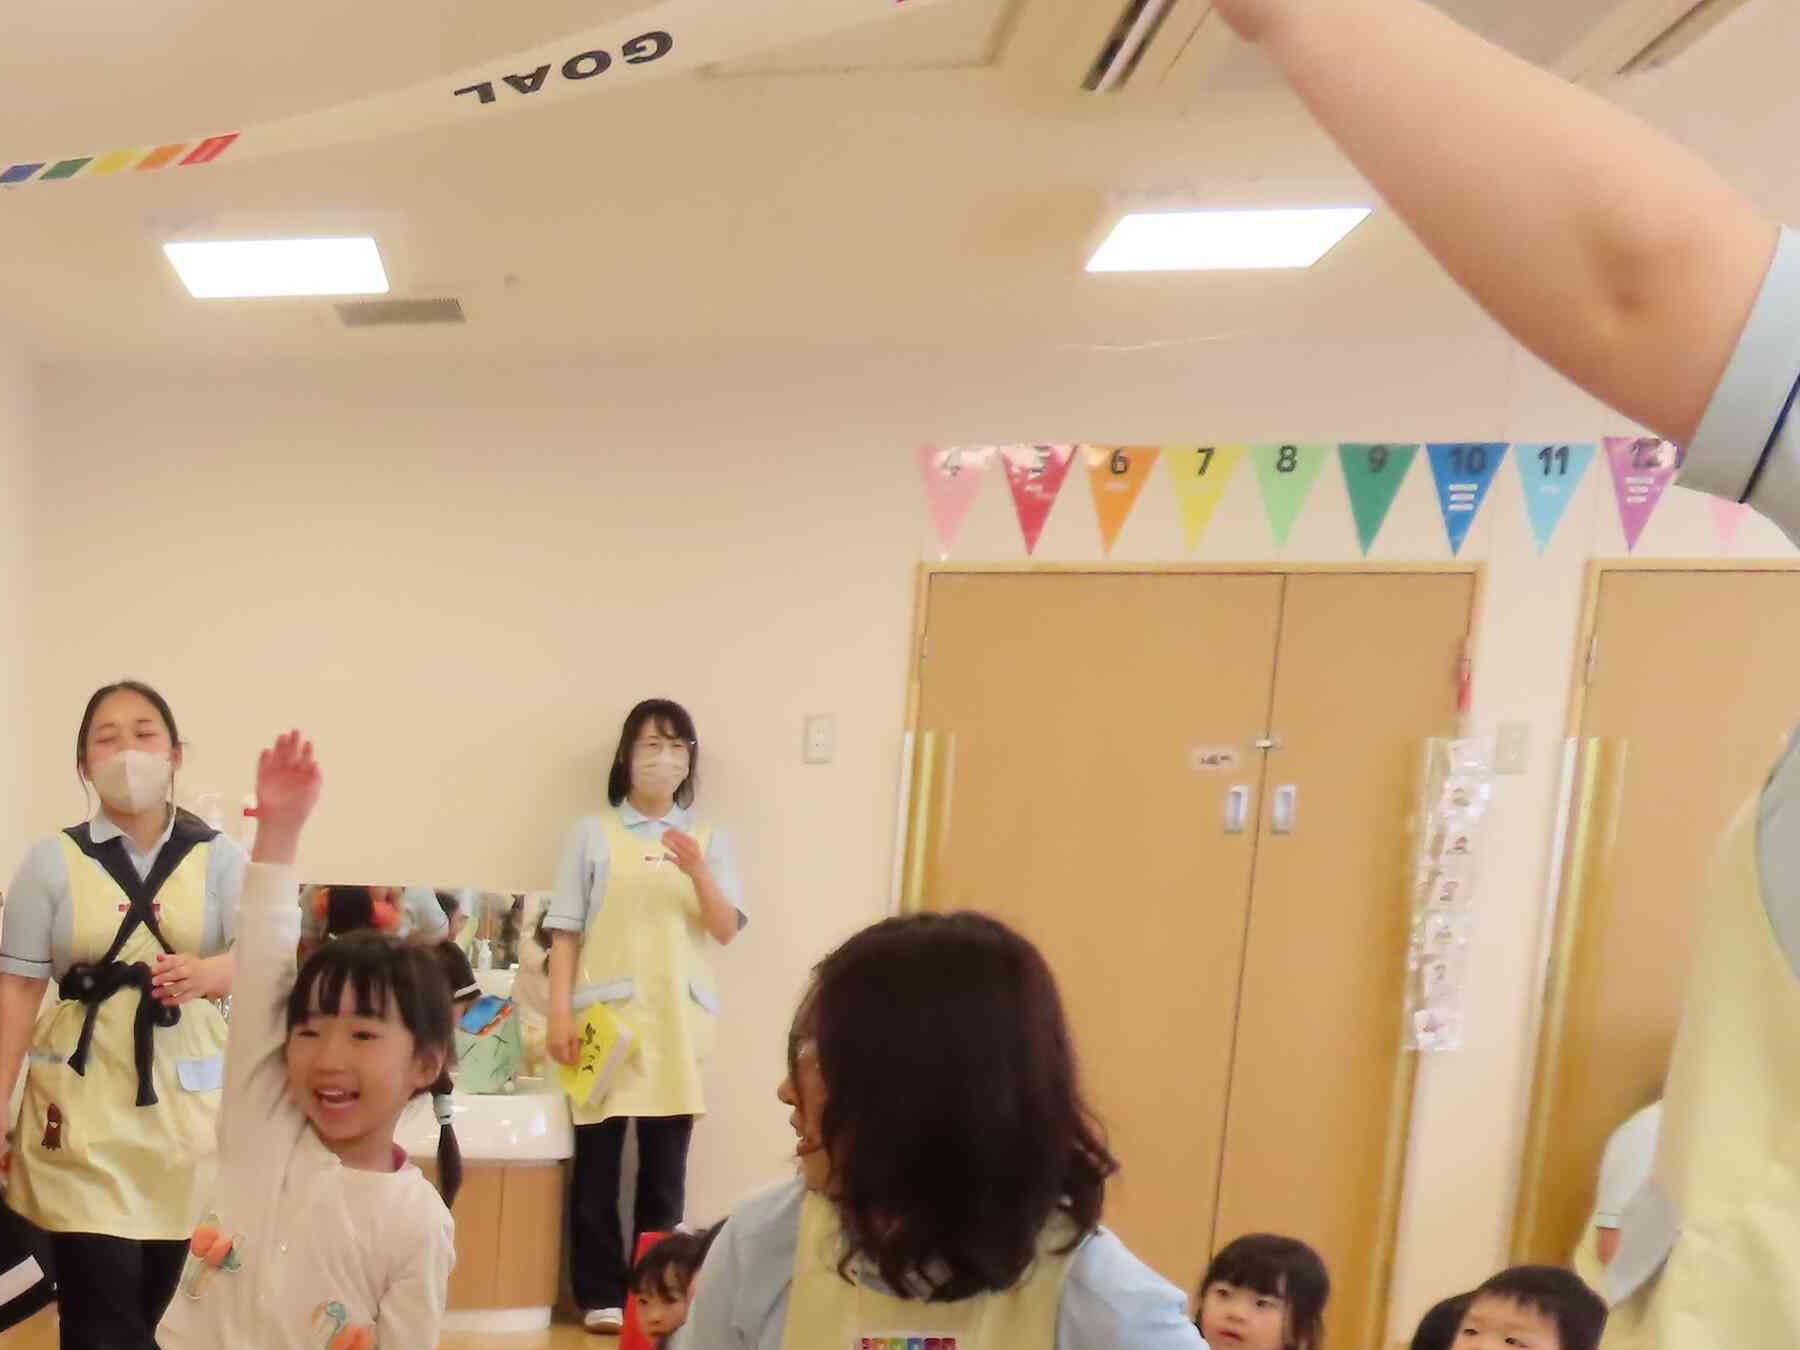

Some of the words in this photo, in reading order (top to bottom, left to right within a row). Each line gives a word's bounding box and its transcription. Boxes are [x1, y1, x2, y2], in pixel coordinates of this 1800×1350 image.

[453, 30, 674, 104] GOAL
[1110, 448, 1130, 475] 6
[1197, 446, 1216, 477] 7
[1276, 444, 1298, 473] 8
[1367, 445, 1389, 474] 9
[1450, 446, 1487, 475] 10
[1537, 445, 1570, 476] 11
